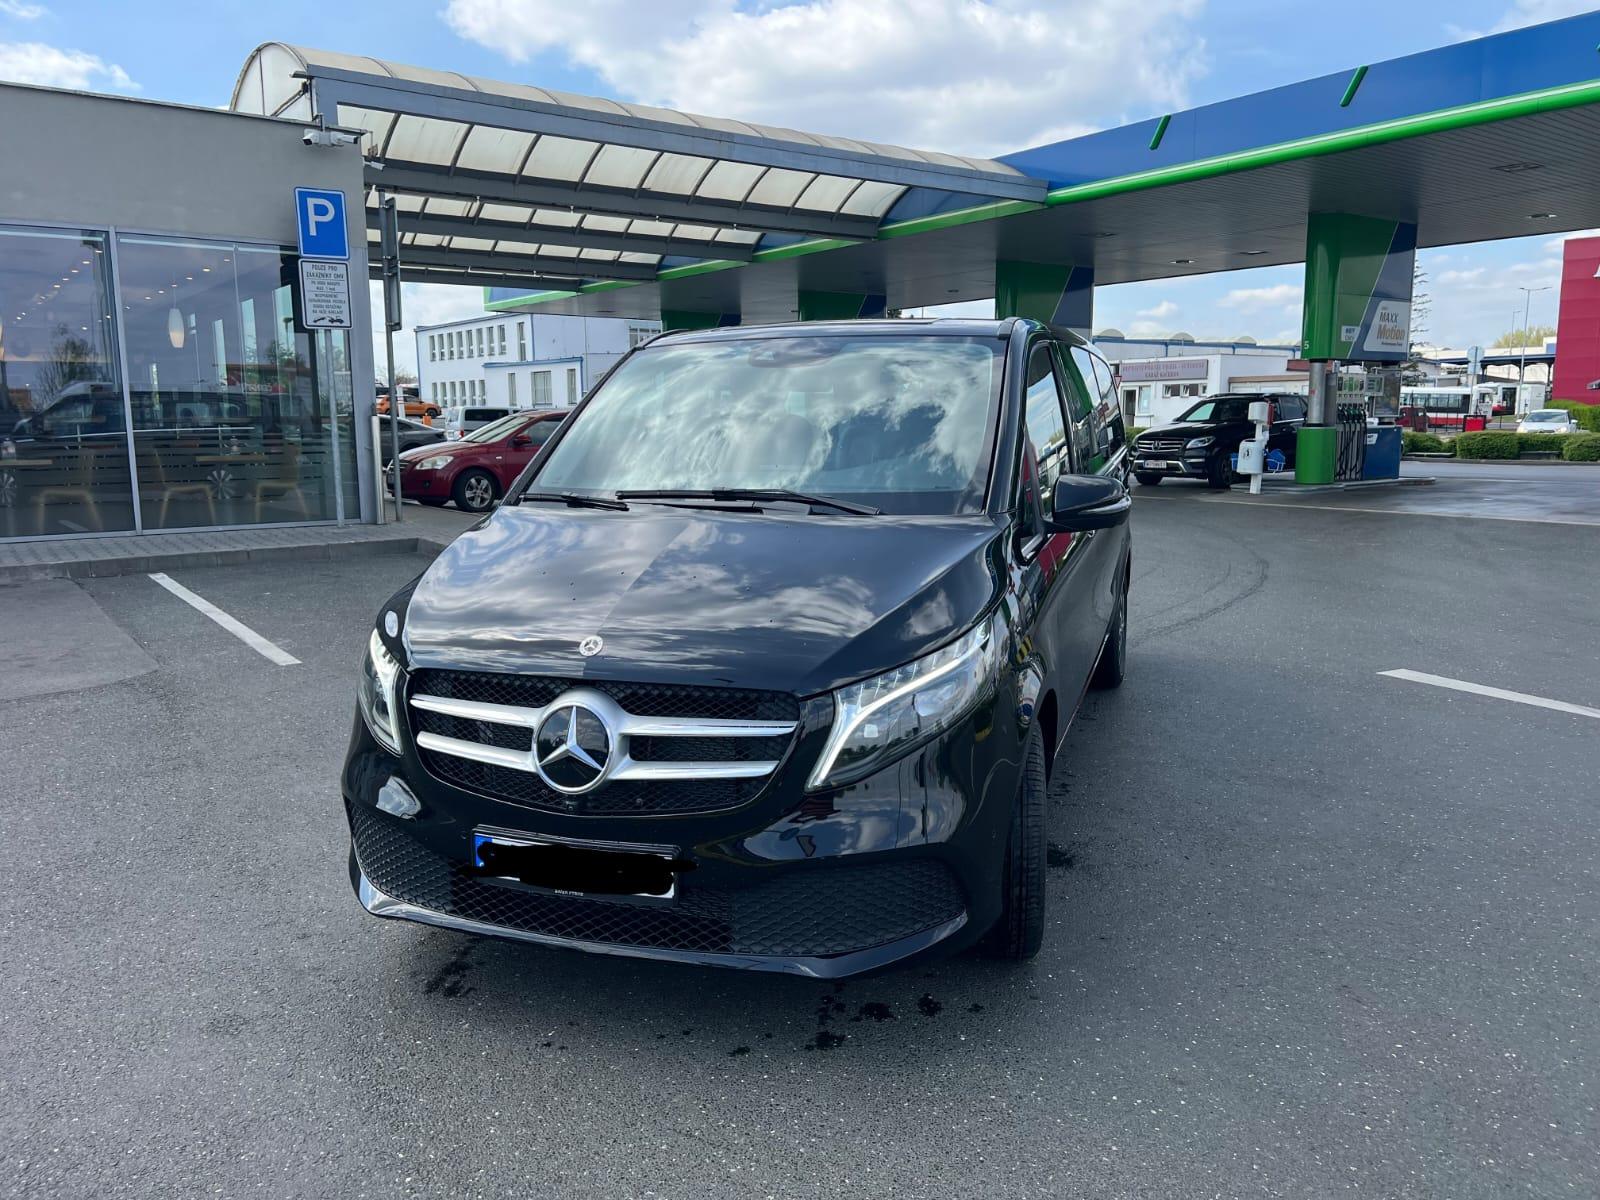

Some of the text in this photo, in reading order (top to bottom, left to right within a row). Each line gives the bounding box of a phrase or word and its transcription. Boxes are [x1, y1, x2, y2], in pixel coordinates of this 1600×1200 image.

[306, 197, 335, 236] P
[1380, 311, 1399, 323] MAXX
[1377, 324, 1406, 341] Motion
